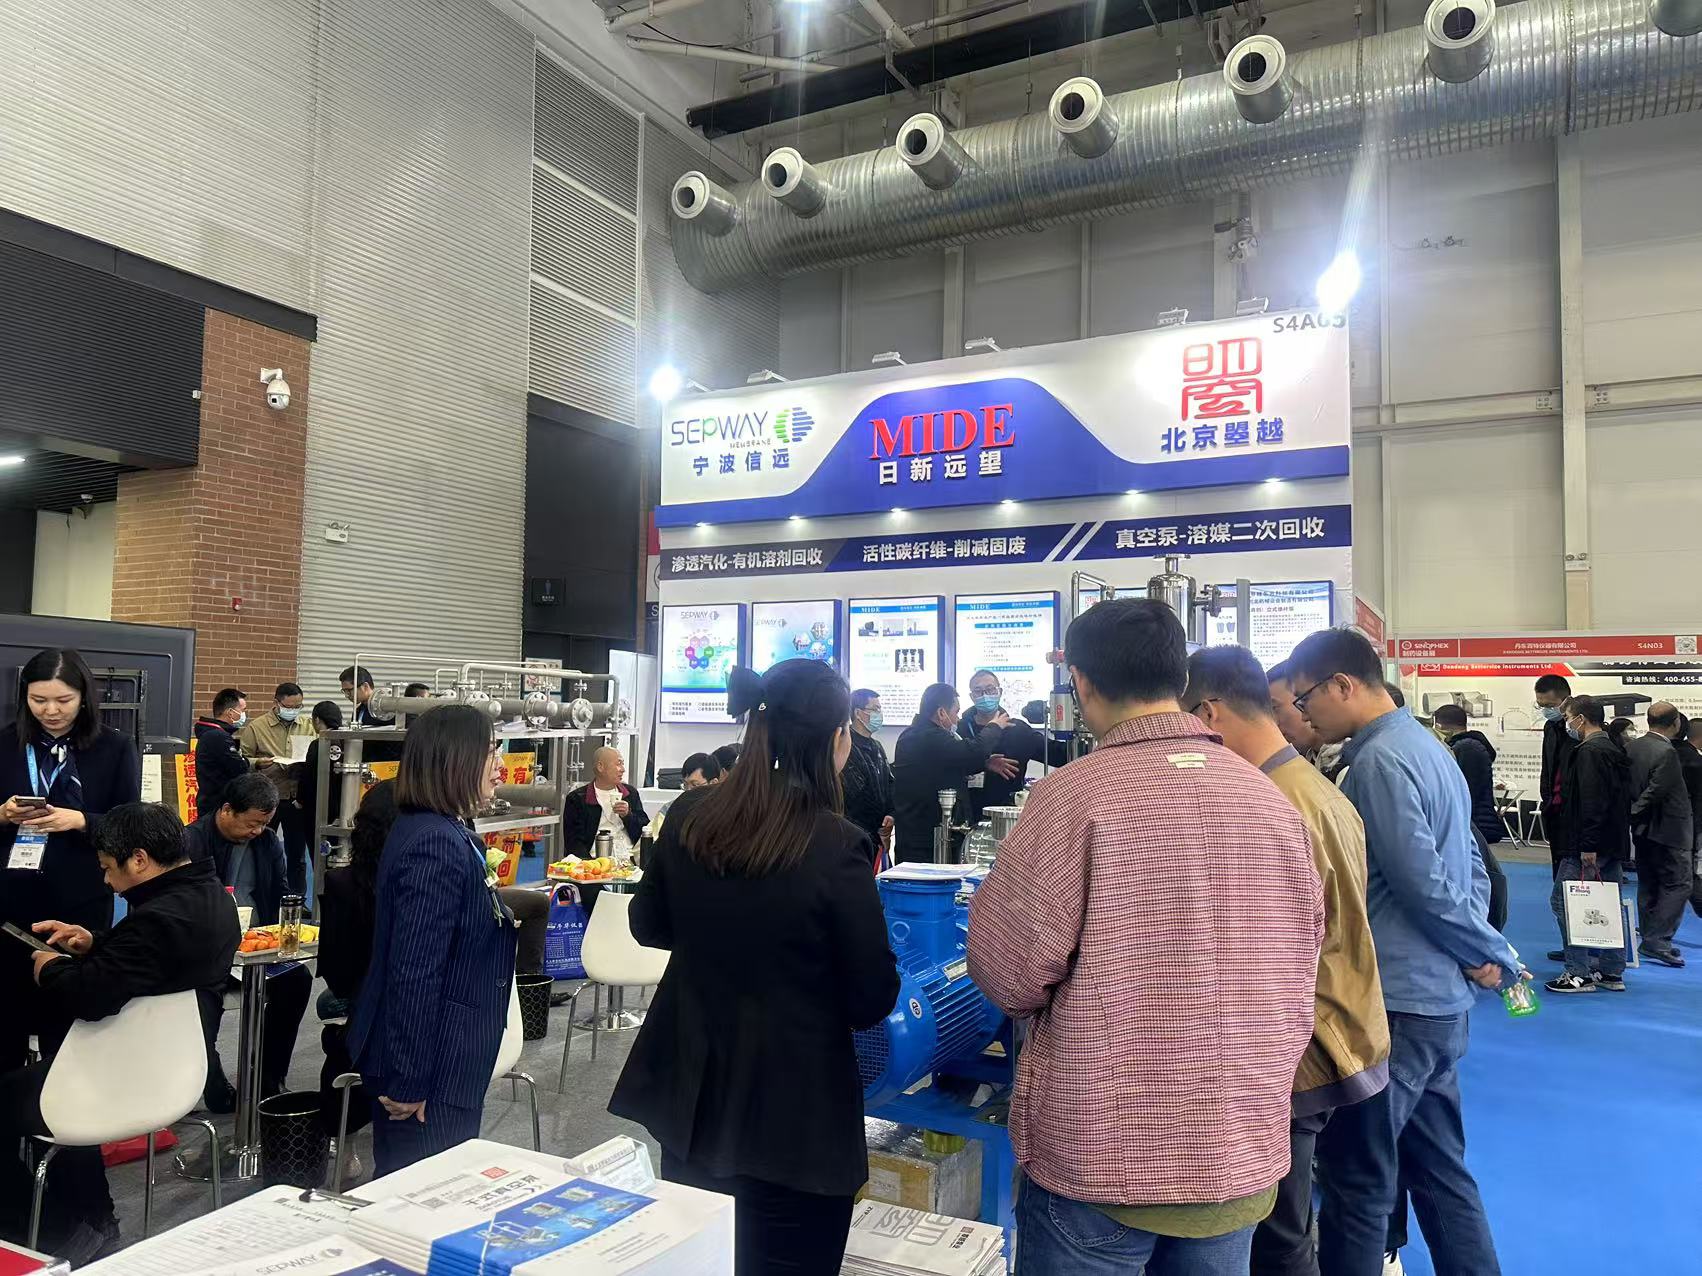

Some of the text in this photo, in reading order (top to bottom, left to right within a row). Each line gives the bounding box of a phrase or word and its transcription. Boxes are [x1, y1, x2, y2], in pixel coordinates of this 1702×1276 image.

[670, 411, 768, 446] SEPWAY
[869, 403, 1015, 459] MIDE
[693, 448, 790, 477] 宁波信远
[879, 450, 1003, 485] 日新远望
[863, 536, 1026, 562] 活性碳纤维-削减固废
[1115, 517, 1325, 549] 真空泵-溶媒二次回收
[671, 548, 822, 573] 渗透汽化-有机溶剂回收
